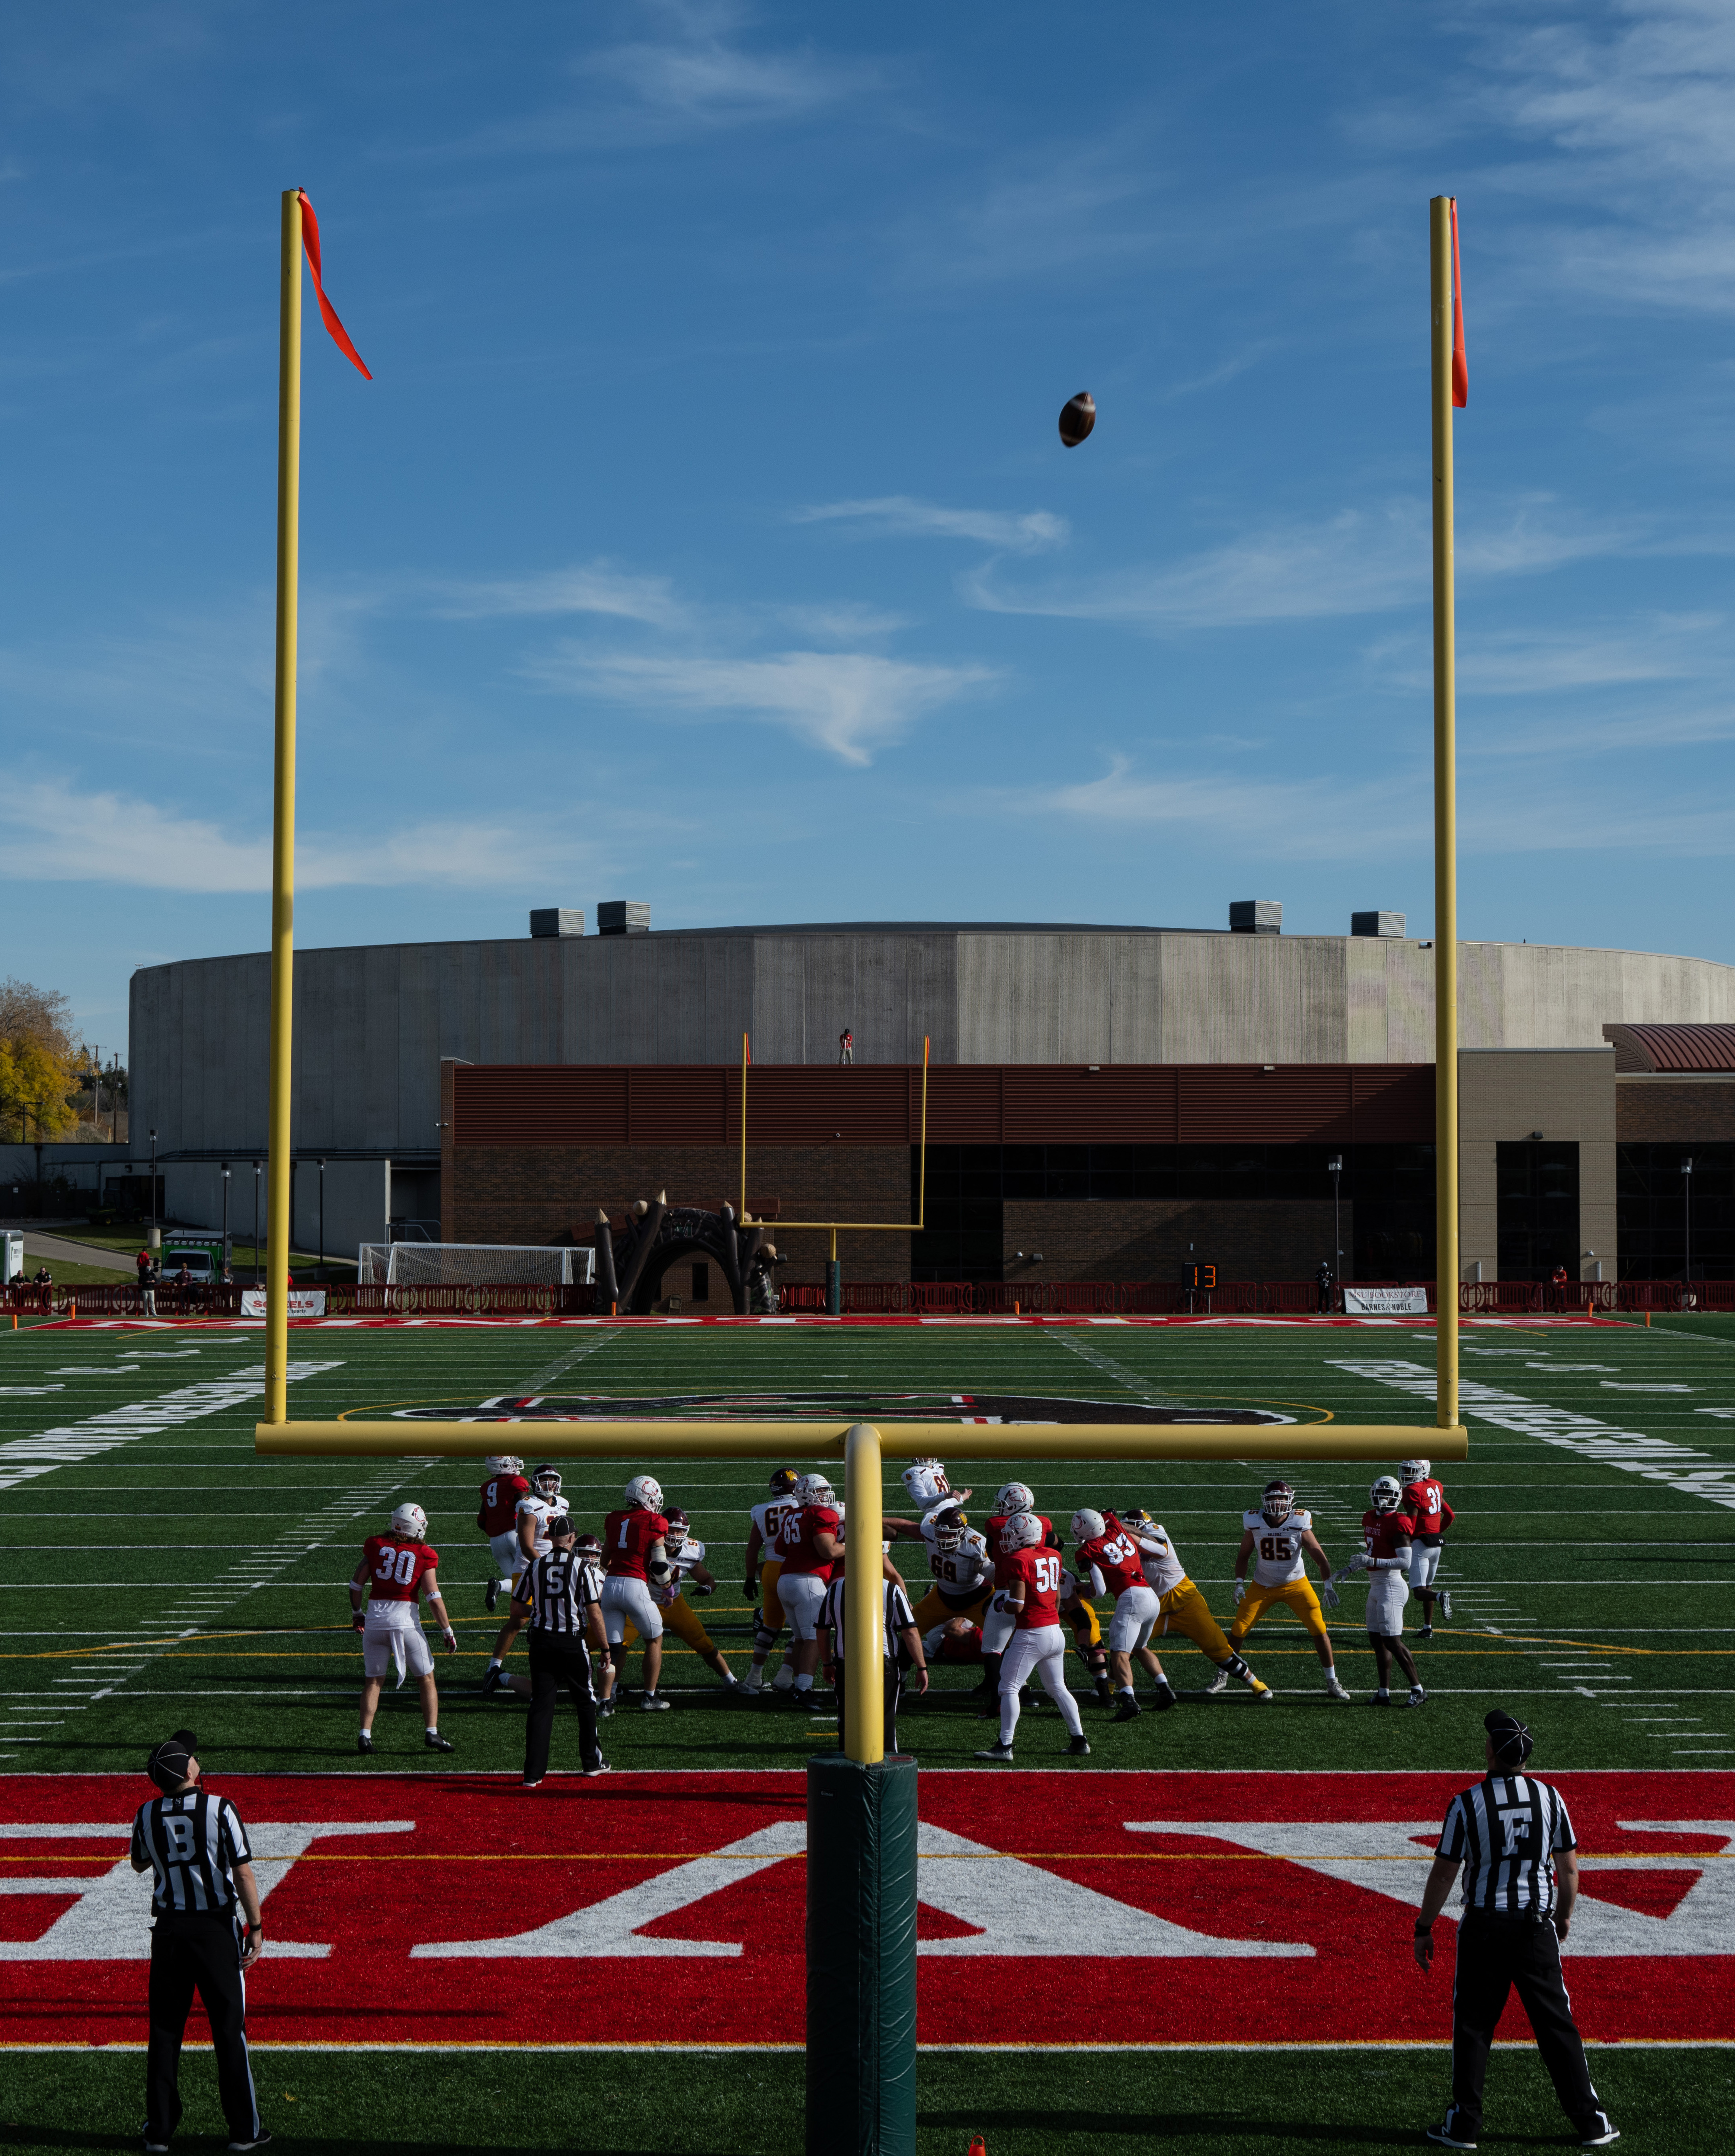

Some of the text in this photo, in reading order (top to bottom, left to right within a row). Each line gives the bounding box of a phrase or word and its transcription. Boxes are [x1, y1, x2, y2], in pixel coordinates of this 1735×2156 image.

[673, 1222, 694, 1238] M
[1194, 1265, 1215, 1287] 13
[487, 1482, 498, 1507] 9
[933, 1475, 950, 1493] 81
[1427, 1485, 1441, 1515] 31
[618, 1519, 630, 1549] 1
[784, 1513, 803, 1545] 65
[1103, 1533, 1136, 1565] 83
[1260, 1537, 1291, 1561] 85
[376, 1546, 416, 1585] 30
[546, 1566, 564, 1594] S
[931, 1554, 957, 1583] 69
[1035, 1556, 1059, 1593] 50
[162, 1815, 196, 1862] B
[1498, 1807, 1533, 1856] F
